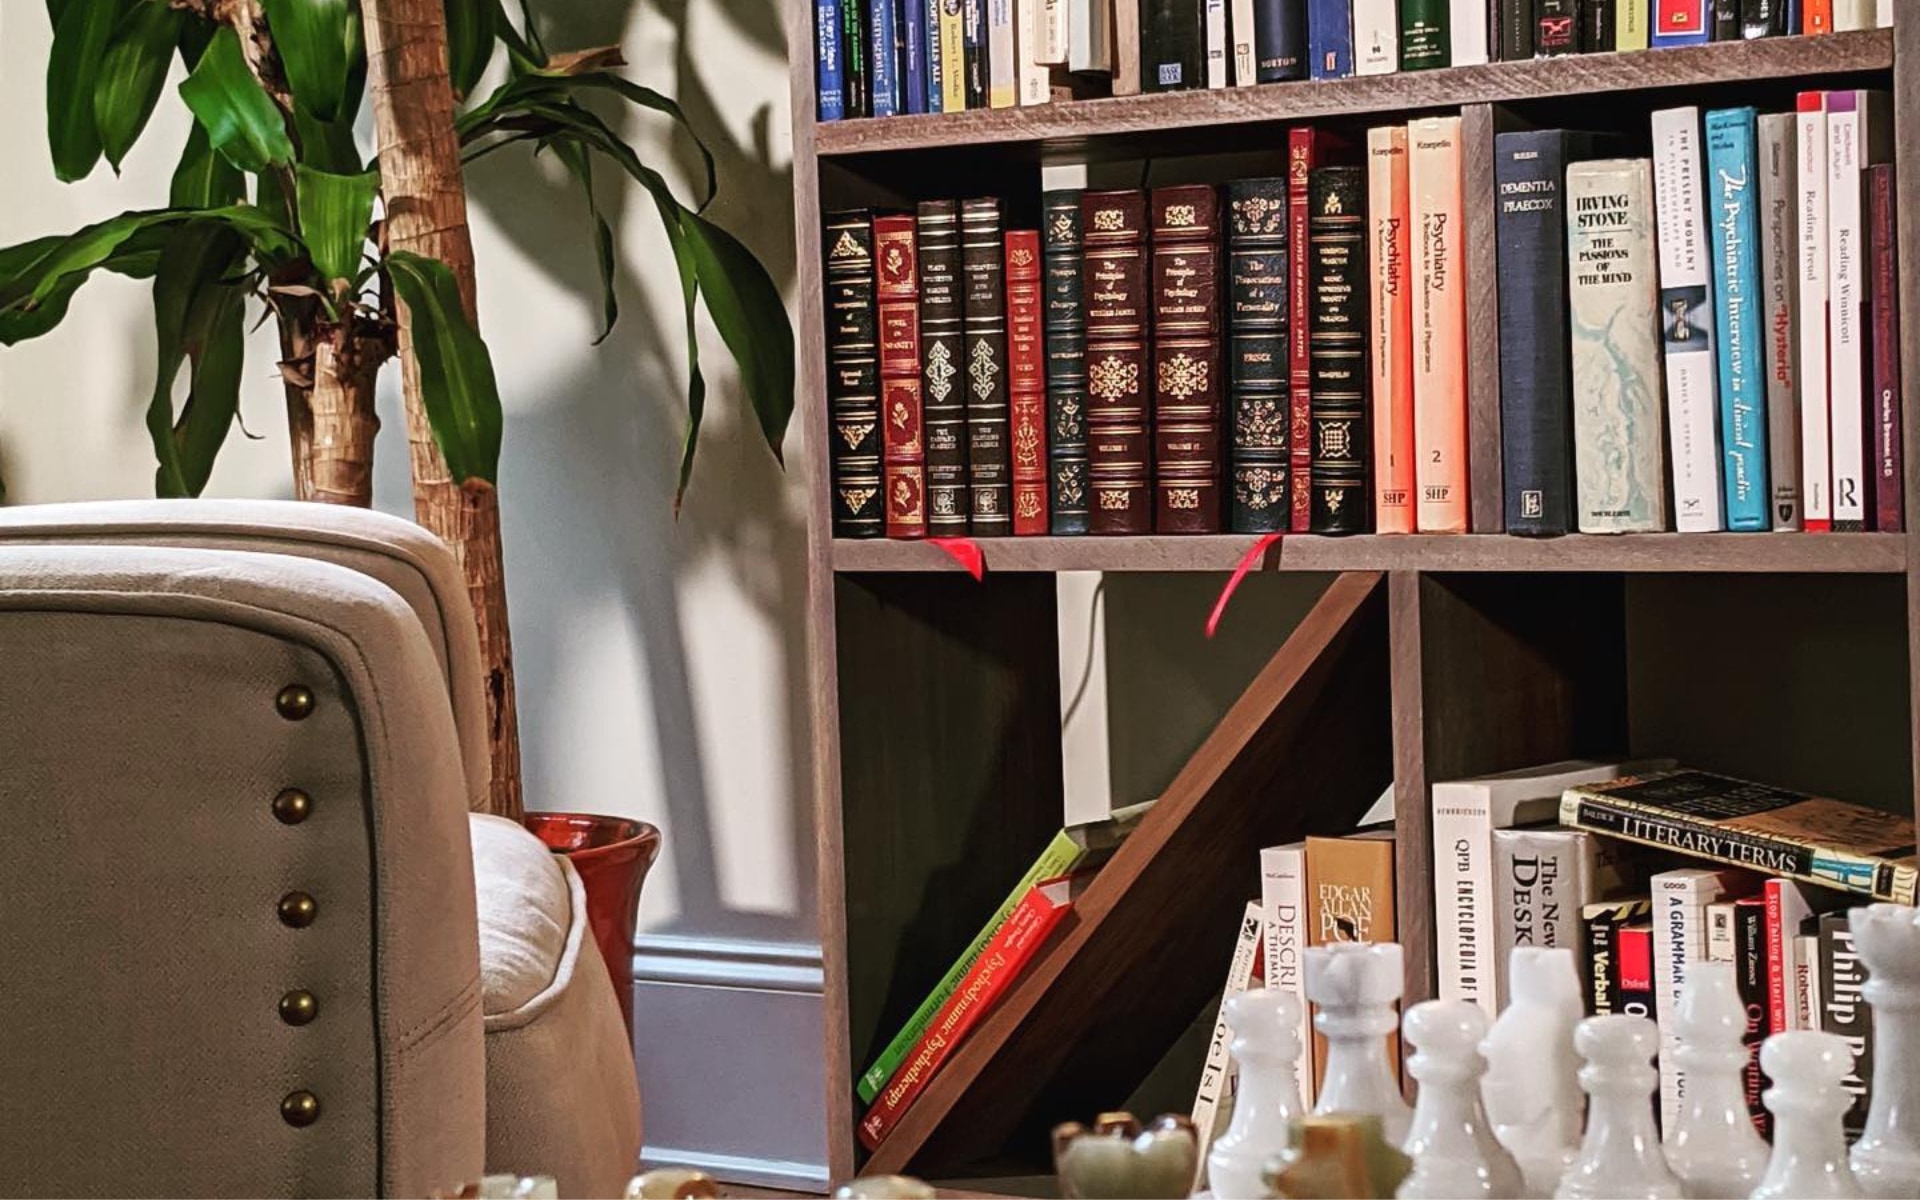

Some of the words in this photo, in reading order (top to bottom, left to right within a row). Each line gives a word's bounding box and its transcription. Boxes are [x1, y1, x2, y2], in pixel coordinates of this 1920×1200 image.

[930, 31, 940, 62] TELLS
[1680, 129, 1689, 151] THE
[1501, 181, 1555, 194] DEMENTIA
[1681, 159, 1692, 212] PRESENT
[1719, 164, 1746, 200] The
[1504, 199, 1553, 212] PRAECOX
[1576, 194, 1629, 211] IRVING
[1578, 211, 1628, 227] STONE
[1806, 190, 1814, 241] Reading
[1385, 218, 1402, 296] Psychiatry
[1431, 212, 1448, 292] Psychiatry
[1579, 249, 1629, 262] PASSIONS
[1591, 238, 1615, 248] THE
[1683, 219, 1695, 272] MOMENT
[1720, 202, 1744, 294] Psychiatric
[1772, 199, 1786, 285] Perspectives
[1838, 228, 1850, 279] Reading
[1249, 261, 1264, 271] The
[1578, 274, 1600, 285] THE
[1602, 272, 1632, 283] MIND
[1596, 262, 1610, 272] OF
[1807, 246, 1817, 281] Freud
[1236, 301, 1280, 312] Personality
[1774, 287, 1785, 301] on
[1840, 281, 1851, 344] Winnicott
[1728, 298, 1744, 375] Interview
[1774, 304, 1791, 388] "Hysteria"
[1680, 368, 1688, 403] DANIEL
[1732, 379, 1746, 392] in
[1882, 389, 1892, 422] Charles
[1733, 398, 1754, 450] clinical
[1431, 450, 1442, 463] 2
[1728, 451, 1750, 502] practice
[1383, 493, 1405, 504] SHP
[1425, 488, 1448, 500] SHP
[1455, 839, 1470, 873] QPB
[1622, 817, 1724, 856] LITERARY
[1726, 840, 1797, 873] TERMS
[1319, 883, 1371, 901] EDGAR
[1540, 855, 1558, 897] The
[1663, 882, 1687, 890] GOOD
[1320, 899, 1371, 916] ALLAN
[1511, 853, 1538, 944] DESK
[1669, 896, 1682, 907] A
[1768, 893, 1779, 920] Stop
[1320, 914, 1372, 944] POE
[1457, 880, 1476, 971] ENCYCLOPEDIA
[1542, 902, 1559, 949] New
[1747, 915, 1757, 951] William
[1767, 922, 1780, 961] Talking
[1278, 905, 1297, 994] DESCRI
[942, 952, 1006, 1037] Psychodynamic
[1460, 975, 1477, 992] OF
[1593, 950, 1610, 1006] Verbal
[1621, 979, 1650, 988] Oxford
[1771, 976, 1782, 1004] Start
[1797, 963, 1809, 1021] Robert's
[1745, 1003, 1763, 1034] On
[886, 1039, 947, 1111] Psychotherapy
[1199, 1094, 1214, 1104] I
